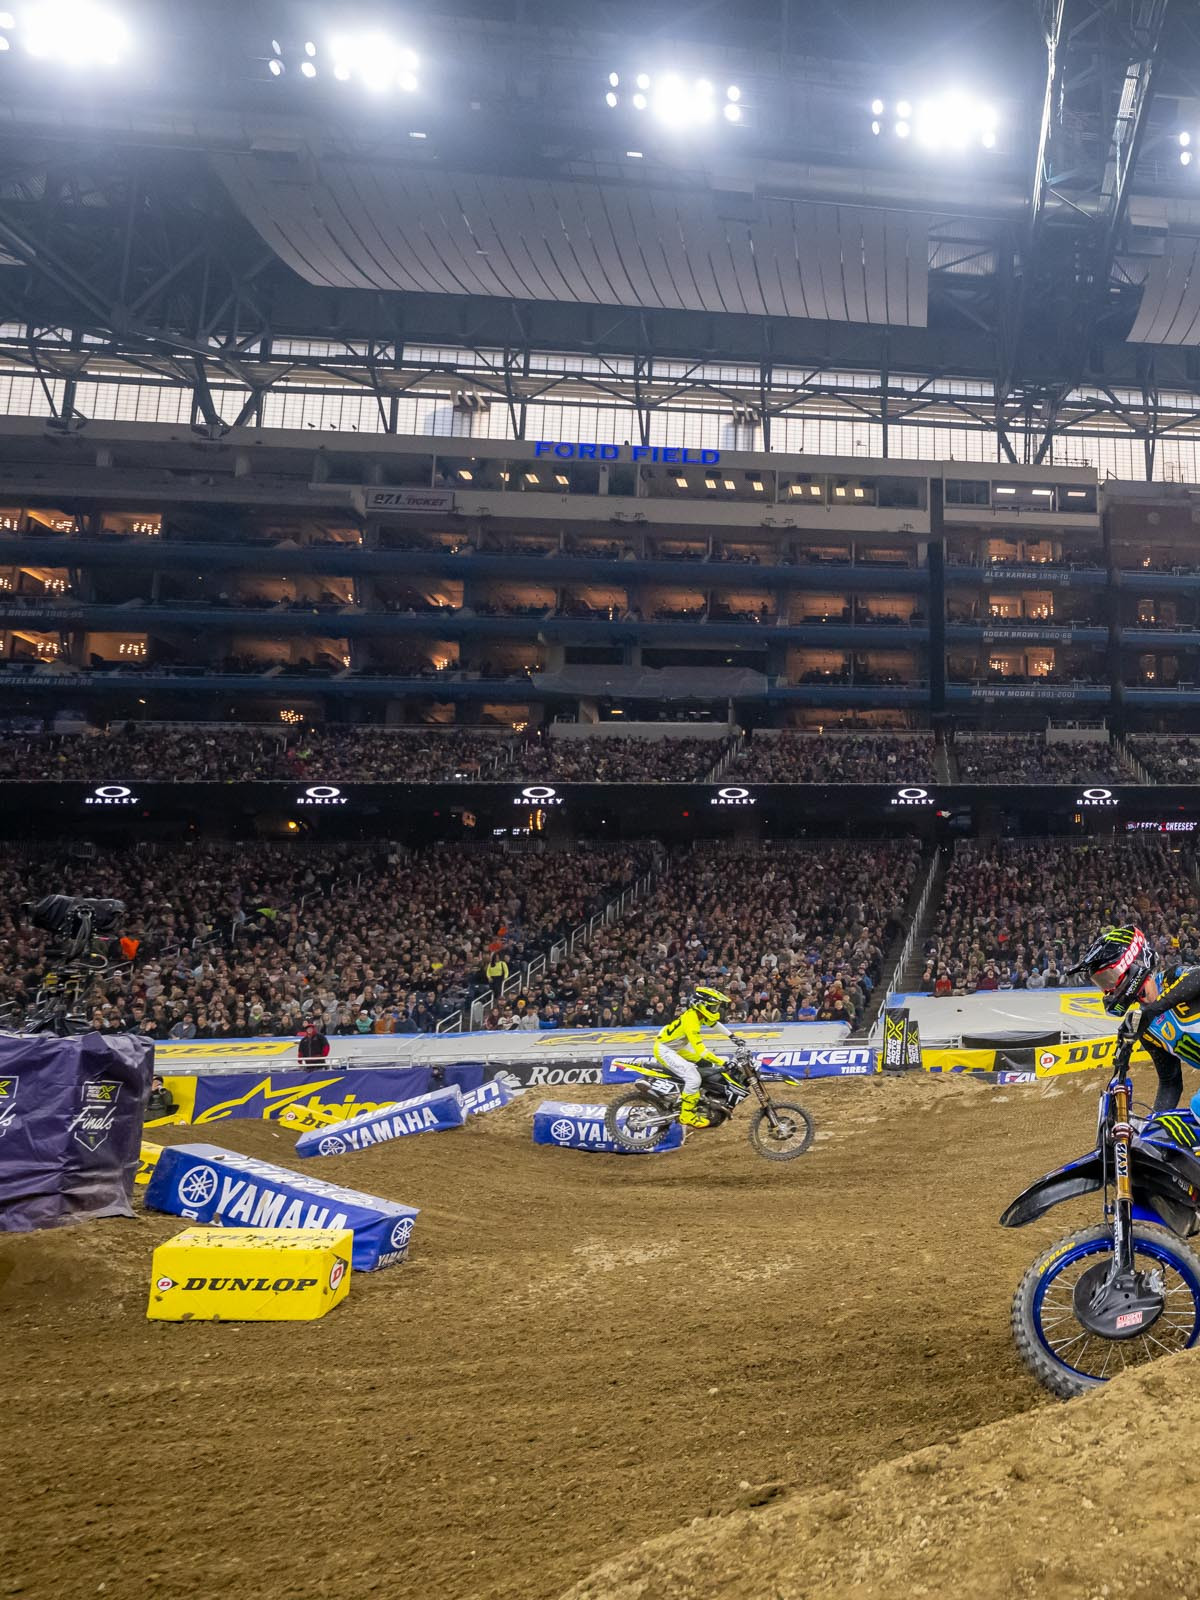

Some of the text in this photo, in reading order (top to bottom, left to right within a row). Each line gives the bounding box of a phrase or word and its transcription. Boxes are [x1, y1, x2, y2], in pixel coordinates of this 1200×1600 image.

[534, 440, 721, 466] FORD FIELD
[984, 571, 1005, 579] ALEX
[1006, 571, 1038, 580] KARRAS
[1011, 631, 1040, 639] BROWN
[970, 689, 1004, 697] HERMAN
[754, 1050, 870, 1067] FALKEN
[526, 1066, 603, 1086] ROCKY
[840, 1066, 868, 1074] TIRES
[67, 1104, 117, 1133] Finals
[343, 1106, 439, 1150] YAMAHA
[216, 1175, 349, 1230] YAMAHA
[1038, 1241, 1076, 1275] DUNLOP
[181, 1277, 319, 1292] DUNLOP
